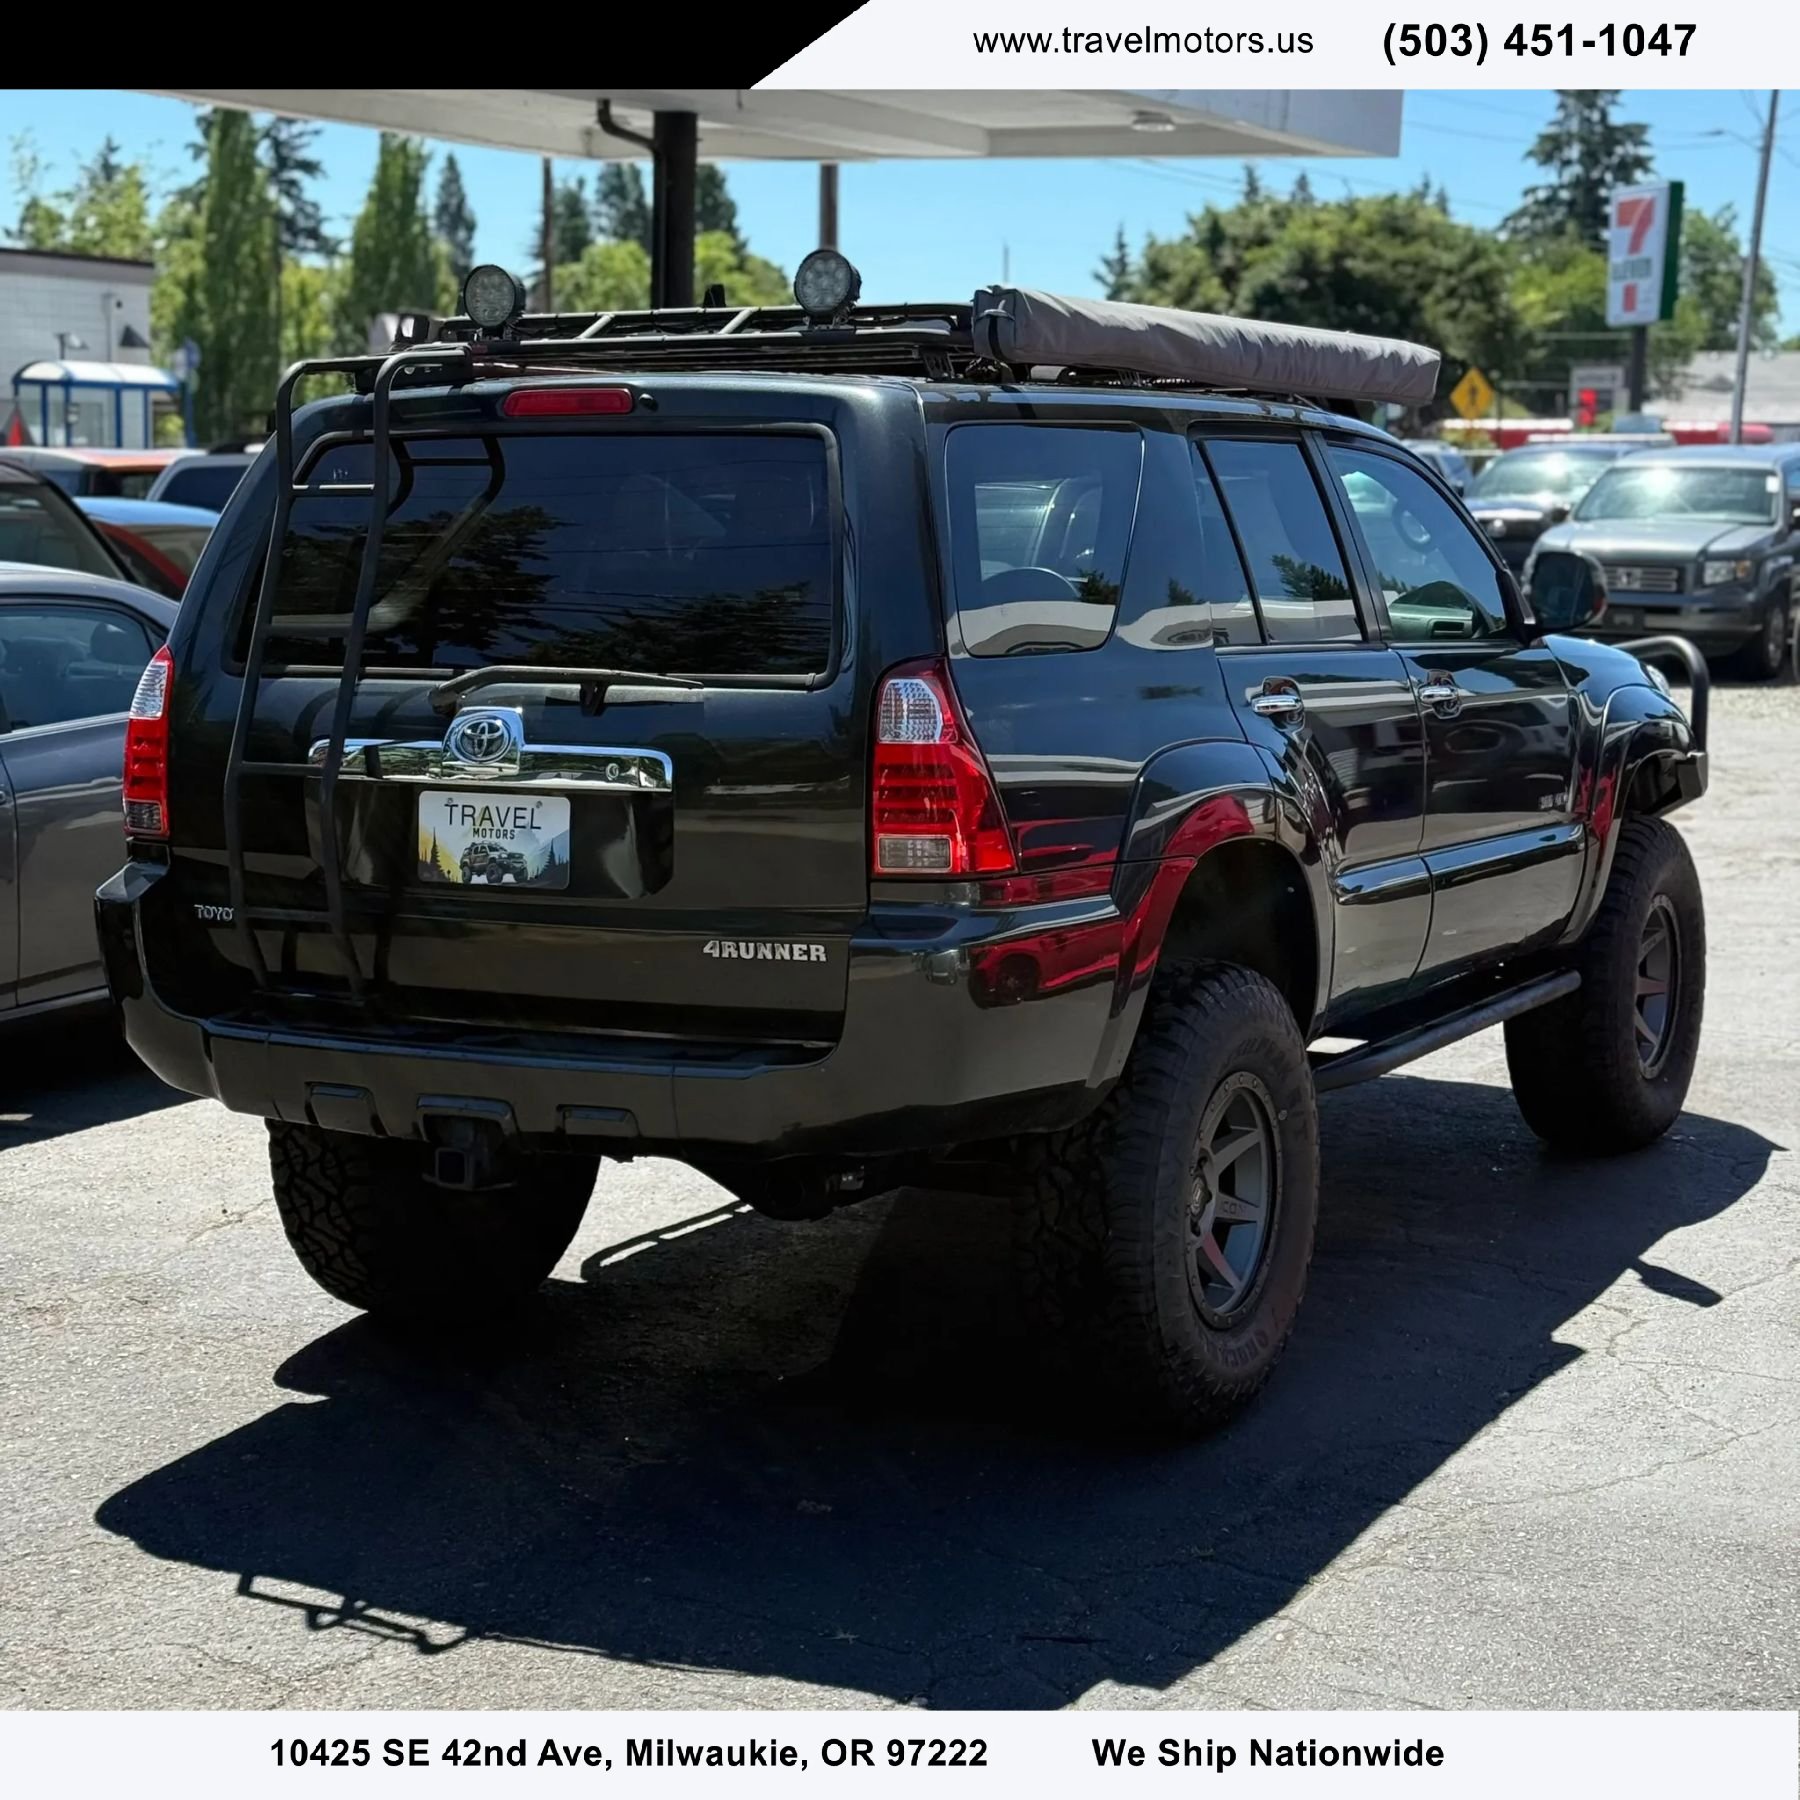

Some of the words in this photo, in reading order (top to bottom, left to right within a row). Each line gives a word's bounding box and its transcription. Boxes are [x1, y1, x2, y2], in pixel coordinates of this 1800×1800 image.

[1617, 198, 1656, 256] 7
[444, 803, 542, 830] TRAVEL
[472, 827, 516, 840] MOTORS
[193, 904, 234, 921] TOYO
[703, 940, 826, 962] 4RUNNER
